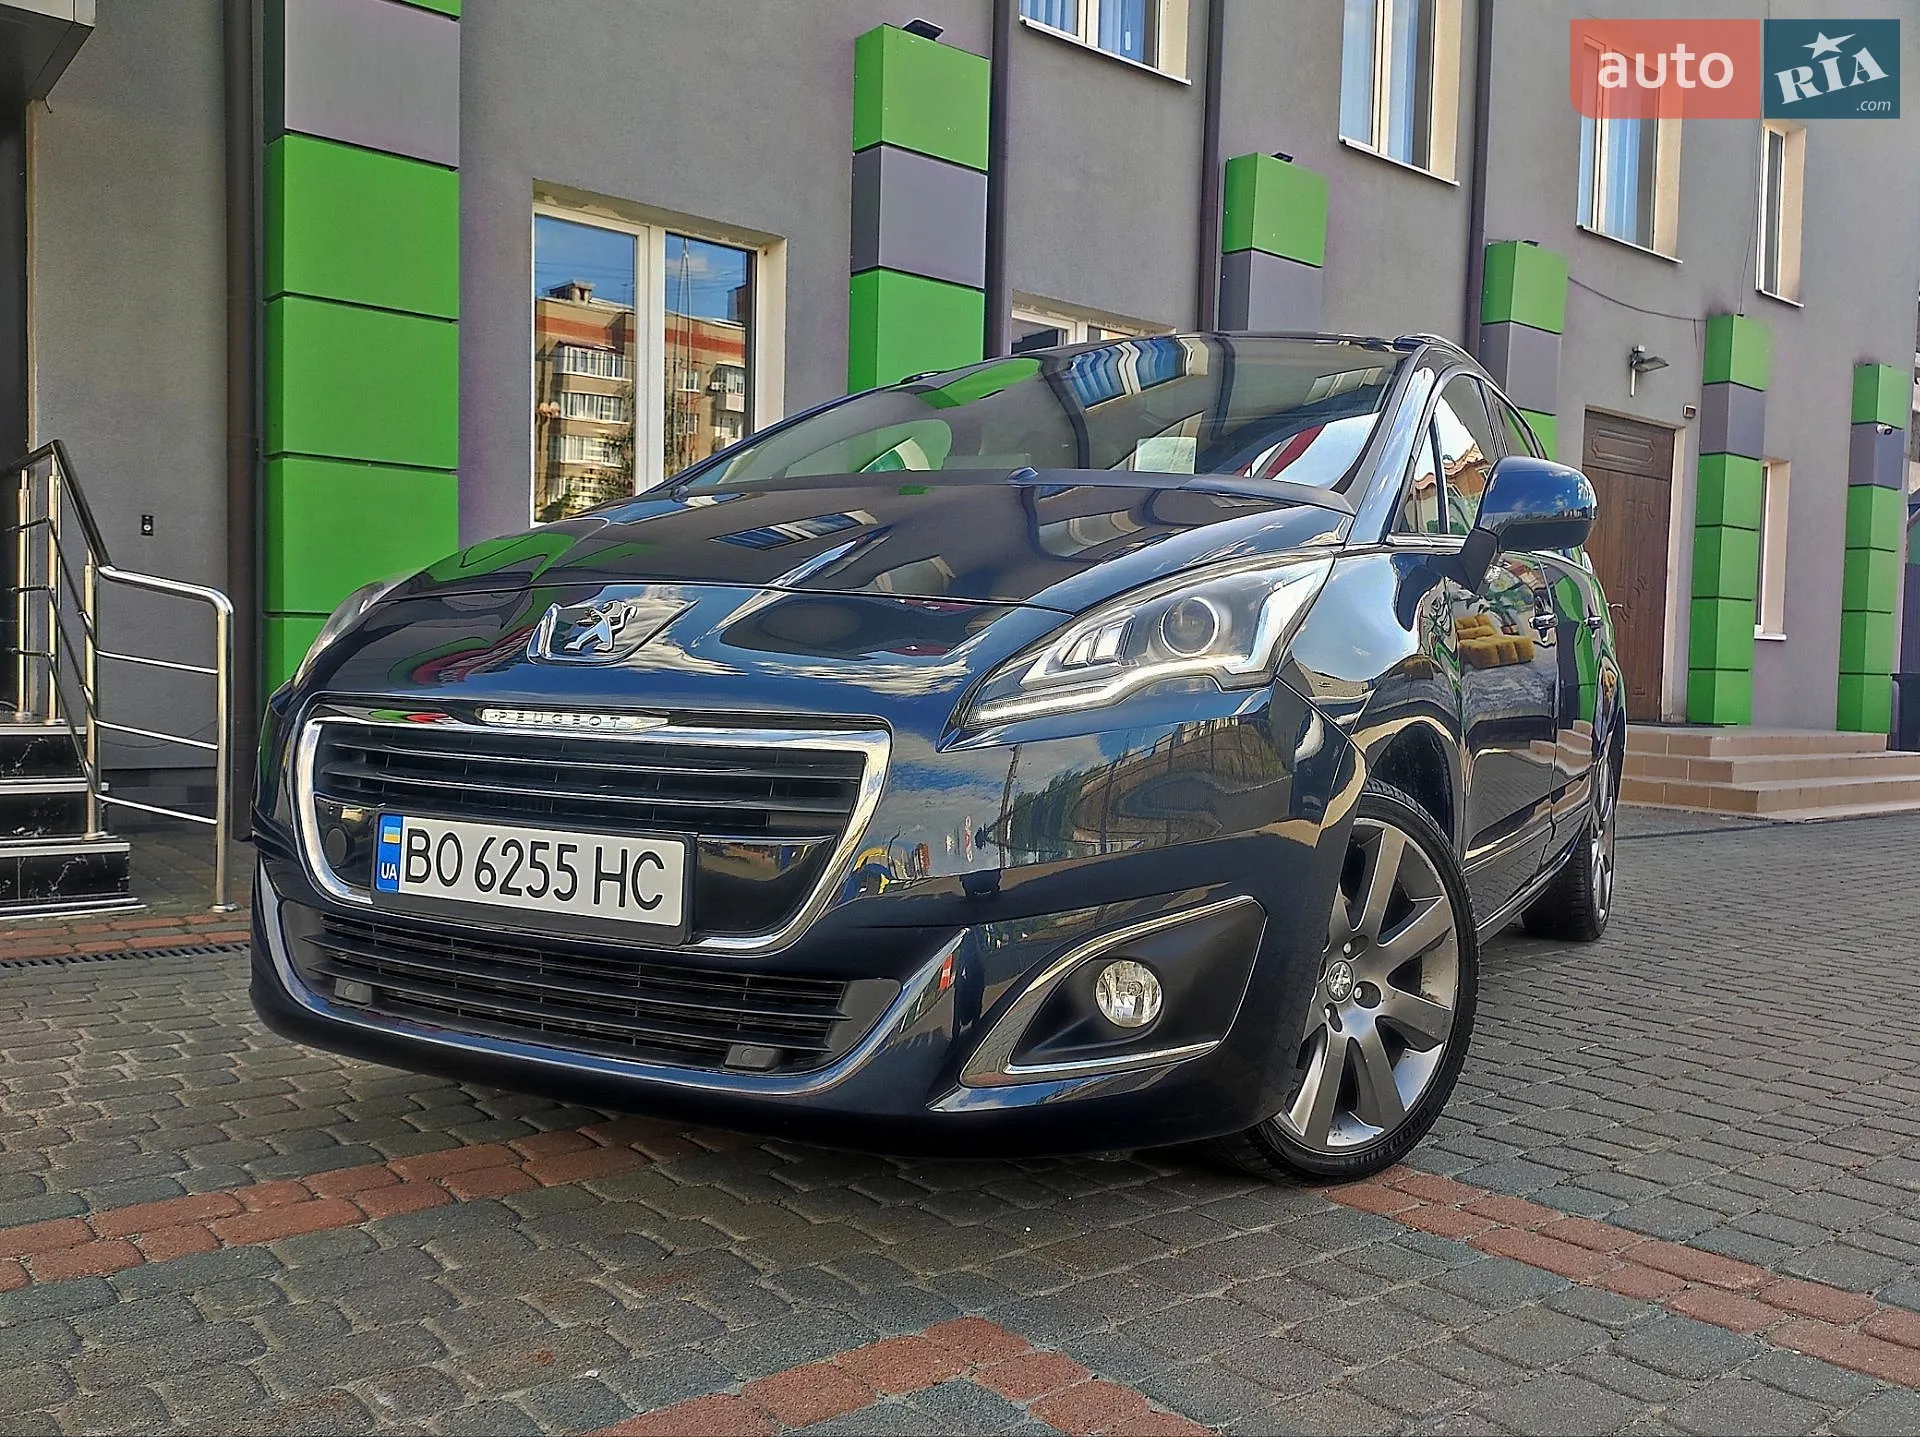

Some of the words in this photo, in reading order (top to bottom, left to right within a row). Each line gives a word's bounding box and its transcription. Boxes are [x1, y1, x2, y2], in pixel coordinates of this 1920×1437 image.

[495, 711, 621, 728] PEUGEOT
[381, 862, 398, 881] UA
[405, 828, 463, 887] BO
[474, 837, 579, 902] 6255
[593, 846, 665, 911] HC
